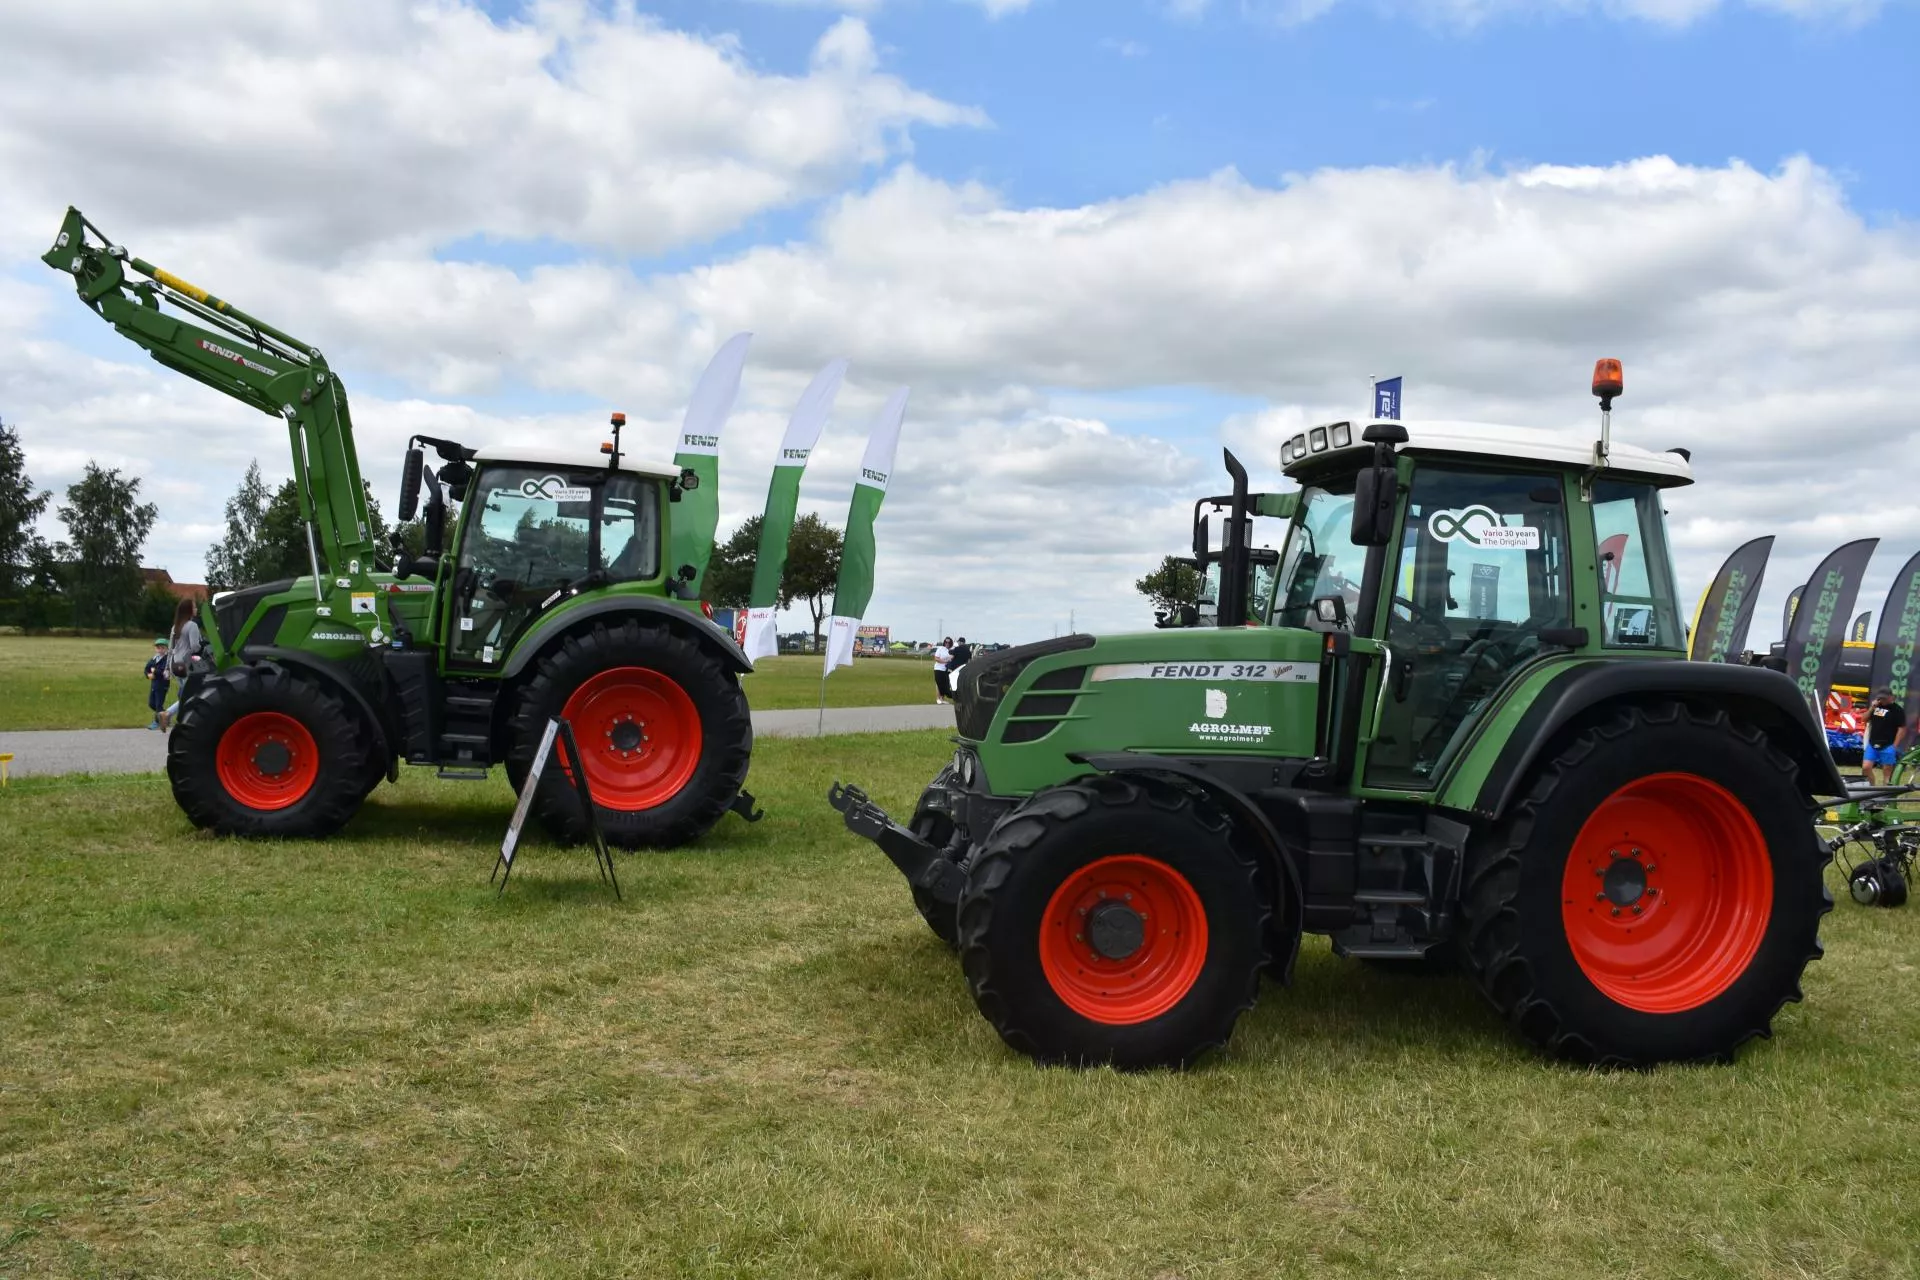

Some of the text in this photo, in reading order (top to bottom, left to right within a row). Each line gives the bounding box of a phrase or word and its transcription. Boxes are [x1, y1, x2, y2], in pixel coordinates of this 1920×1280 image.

[202, 340, 243, 361] FENDT
[862, 468, 888, 484] FENDT
[1500, 539, 1528, 547] Original
[1150, 665, 1225, 678] FENDT
[1230, 665, 1267, 678] 312
[1189, 722, 1273, 736] AGROLMET
[1198, 734, 1264, 743] www.agrolmet.pl
